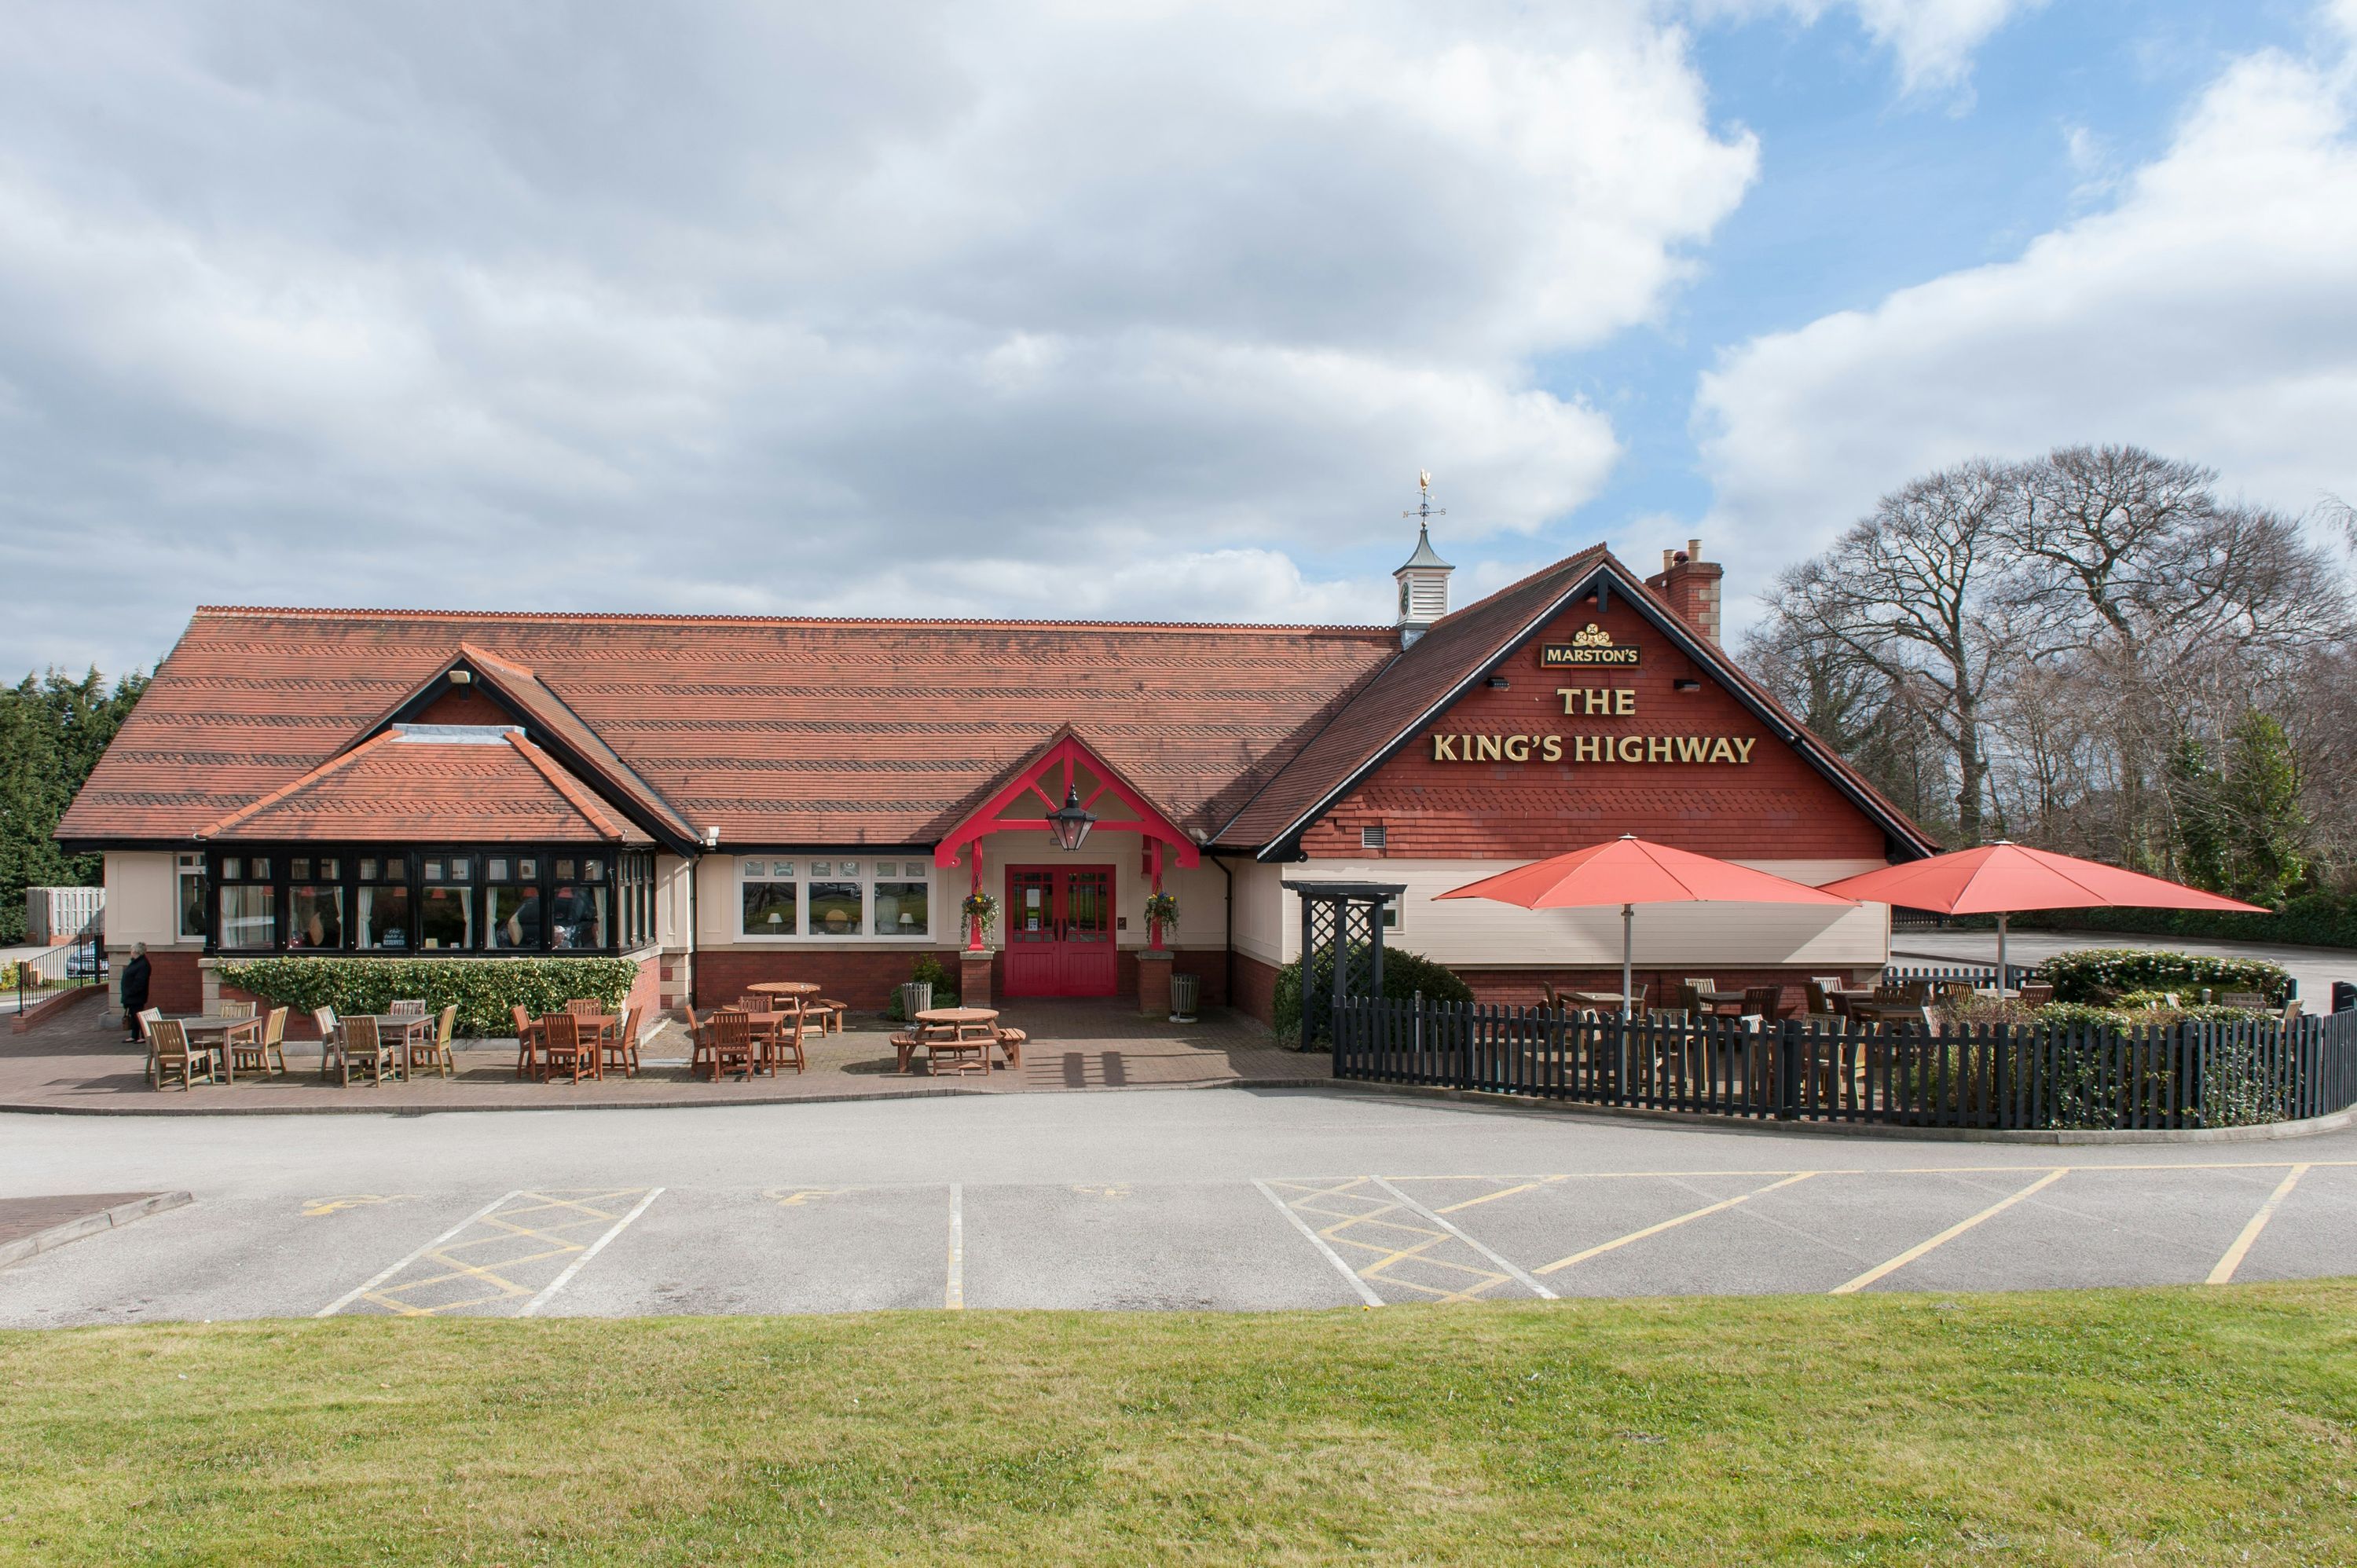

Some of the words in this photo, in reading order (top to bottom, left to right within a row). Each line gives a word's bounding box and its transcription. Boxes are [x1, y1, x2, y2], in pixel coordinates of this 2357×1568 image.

[1547, 649, 1637, 662] MARSTON'S
[1556, 688, 1636, 715] THE
[1434, 735, 1562, 761] KING'S
[1574, 735, 1757, 763] HIGHWAY
